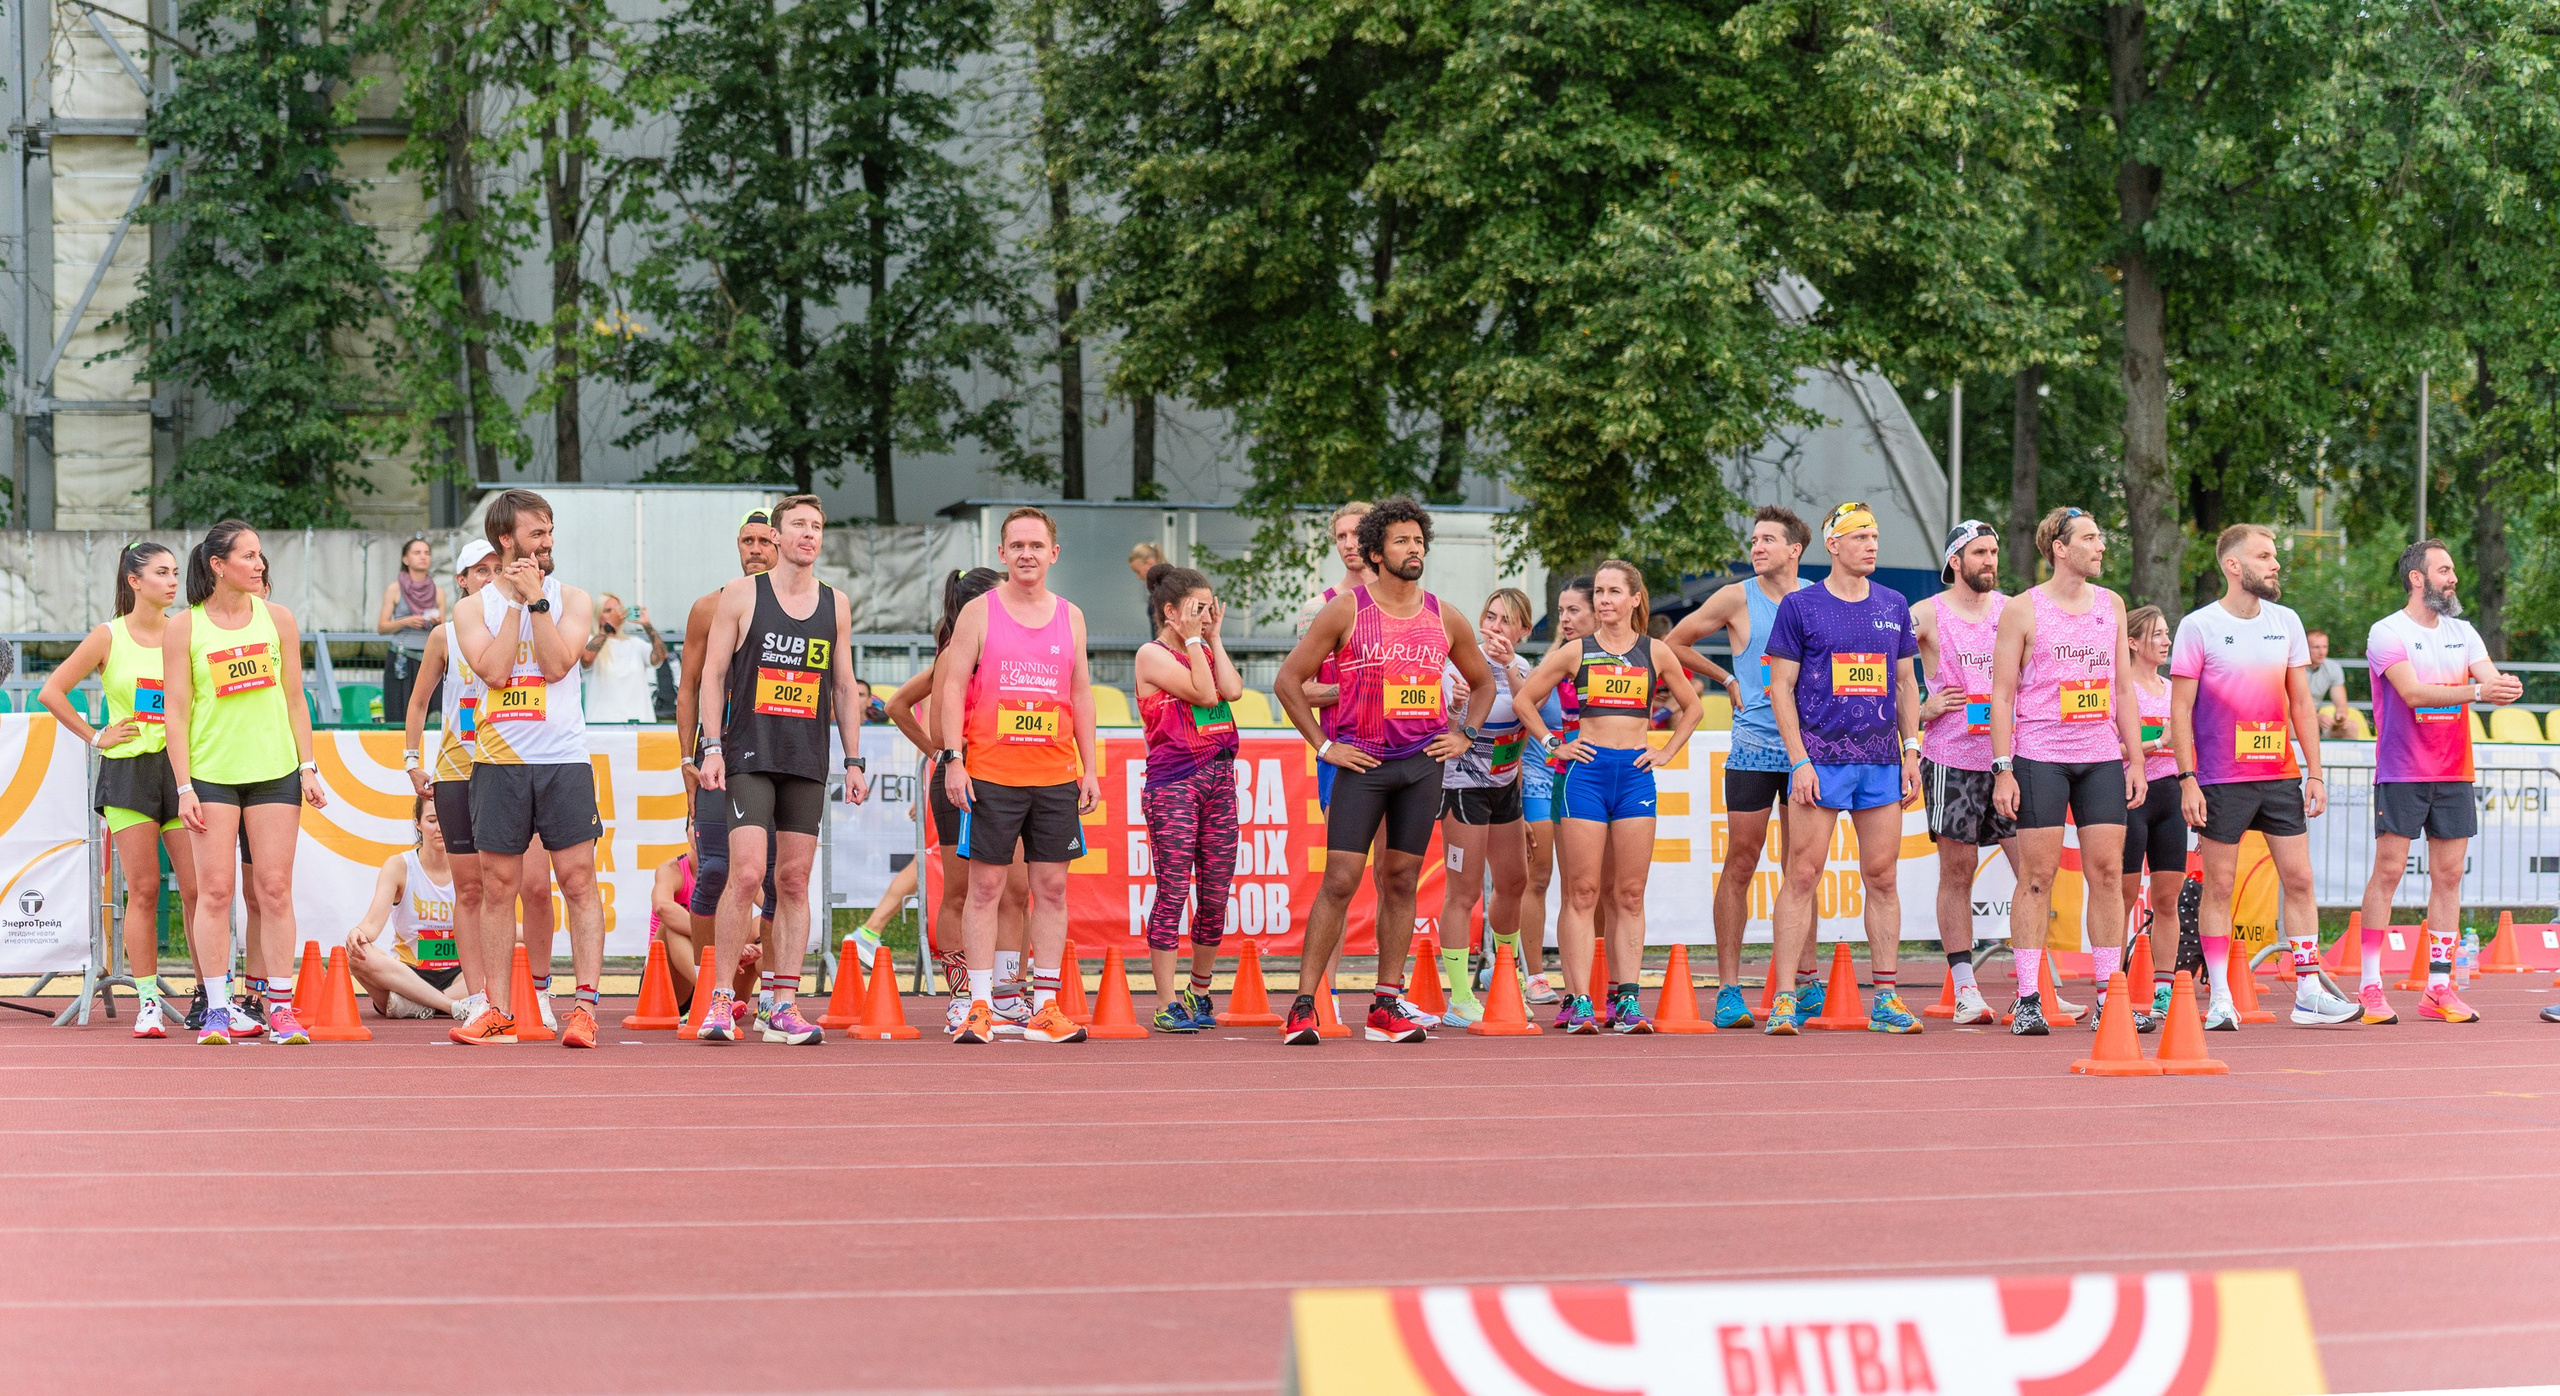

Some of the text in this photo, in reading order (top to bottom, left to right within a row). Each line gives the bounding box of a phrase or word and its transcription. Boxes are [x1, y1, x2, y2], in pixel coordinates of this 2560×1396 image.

[762, 632, 806, 654] SUB
[810, 642, 825, 665] 3
[2054, 645, 2096, 663] Magic
[228, 660, 257, 678] 200
[1001, 660, 1059, 675] RUNNING
[1958, 653, 1994, 670] Magic
[2088, 653, 2111, 673] pills
[1000, 668, 1059, 688] & Sarcasm
[1849, 667, 1882, 682] 209 2
[774, 685, 812, 703] 202 2
[1605, 679, 1642, 695] 207 2
[502, 690, 540, 707] 201 2
[1400, 689, 1435, 704] 206 2
[2078, 693, 2106, 708] 210 2
[1015, 715, 1053, 732] 204 2
[2253, 735, 2281, 749] 211 2
[2503, 787, 2547, 812] VBI
[1452, 853, 1458, 863] 8
[2, 919, 62, 929] ЭнергоТрейд
[434, 942, 456, 957] 201
[1716, 1321, 1938, 1396] БИТВА
